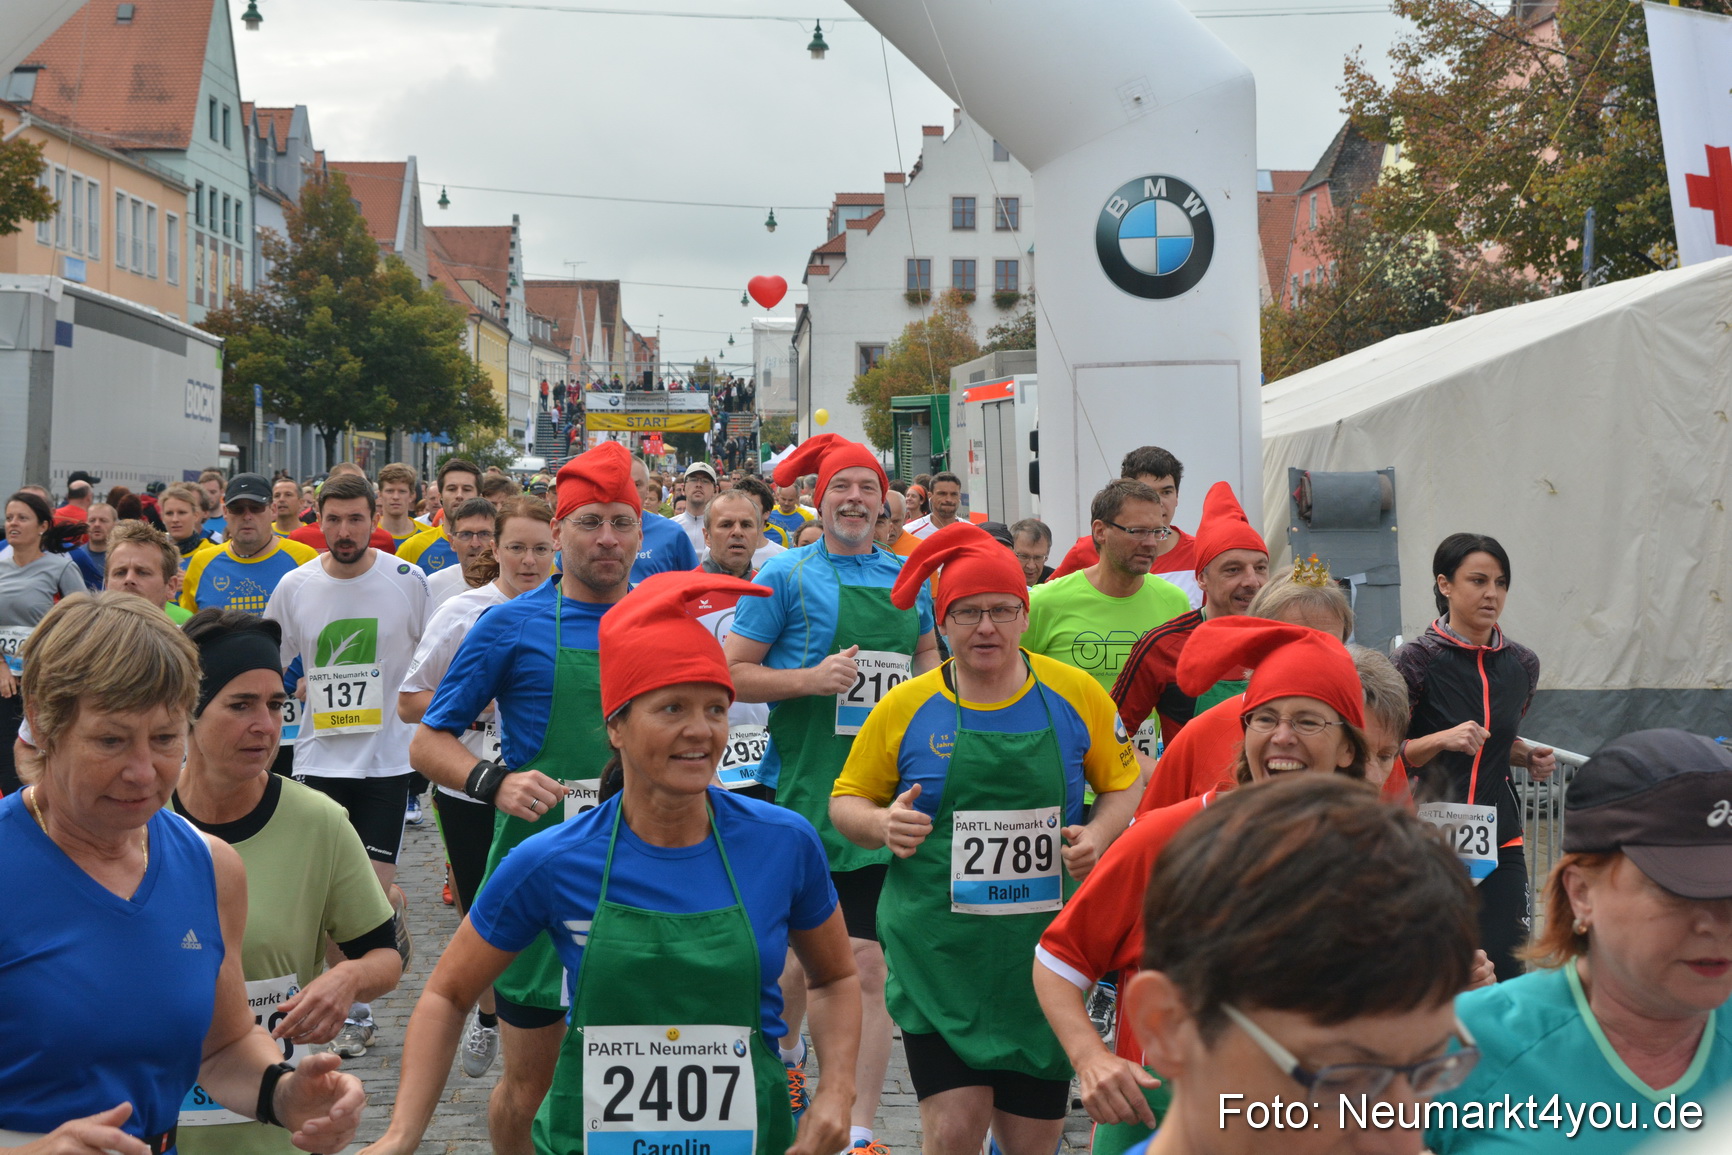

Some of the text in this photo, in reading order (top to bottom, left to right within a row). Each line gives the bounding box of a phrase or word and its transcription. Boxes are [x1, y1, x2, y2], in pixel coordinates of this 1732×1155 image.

[1105, 178, 1206, 219] BMW
[626, 417, 670, 428] START
[309, 671, 369, 682] PARTL Neumarkt
[322, 680, 367, 709] 137
[330, 713, 361, 726] Stefan
[566, 789, 599, 799] PART
[1419, 809, 1484, 821] PARTL Neumarkt
[955, 819, 1044, 832] PARTL Neumarkt
[963, 833, 1053, 875] 2789
[988, 883, 1030, 903] Ralph
[180, 941, 203, 950] adidas
[587, 1041, 728, 1057] PARTL Neumarkt
[602, 1064, 741, 1123] 2407
[632, 1138, 712, 1155] Carolin
